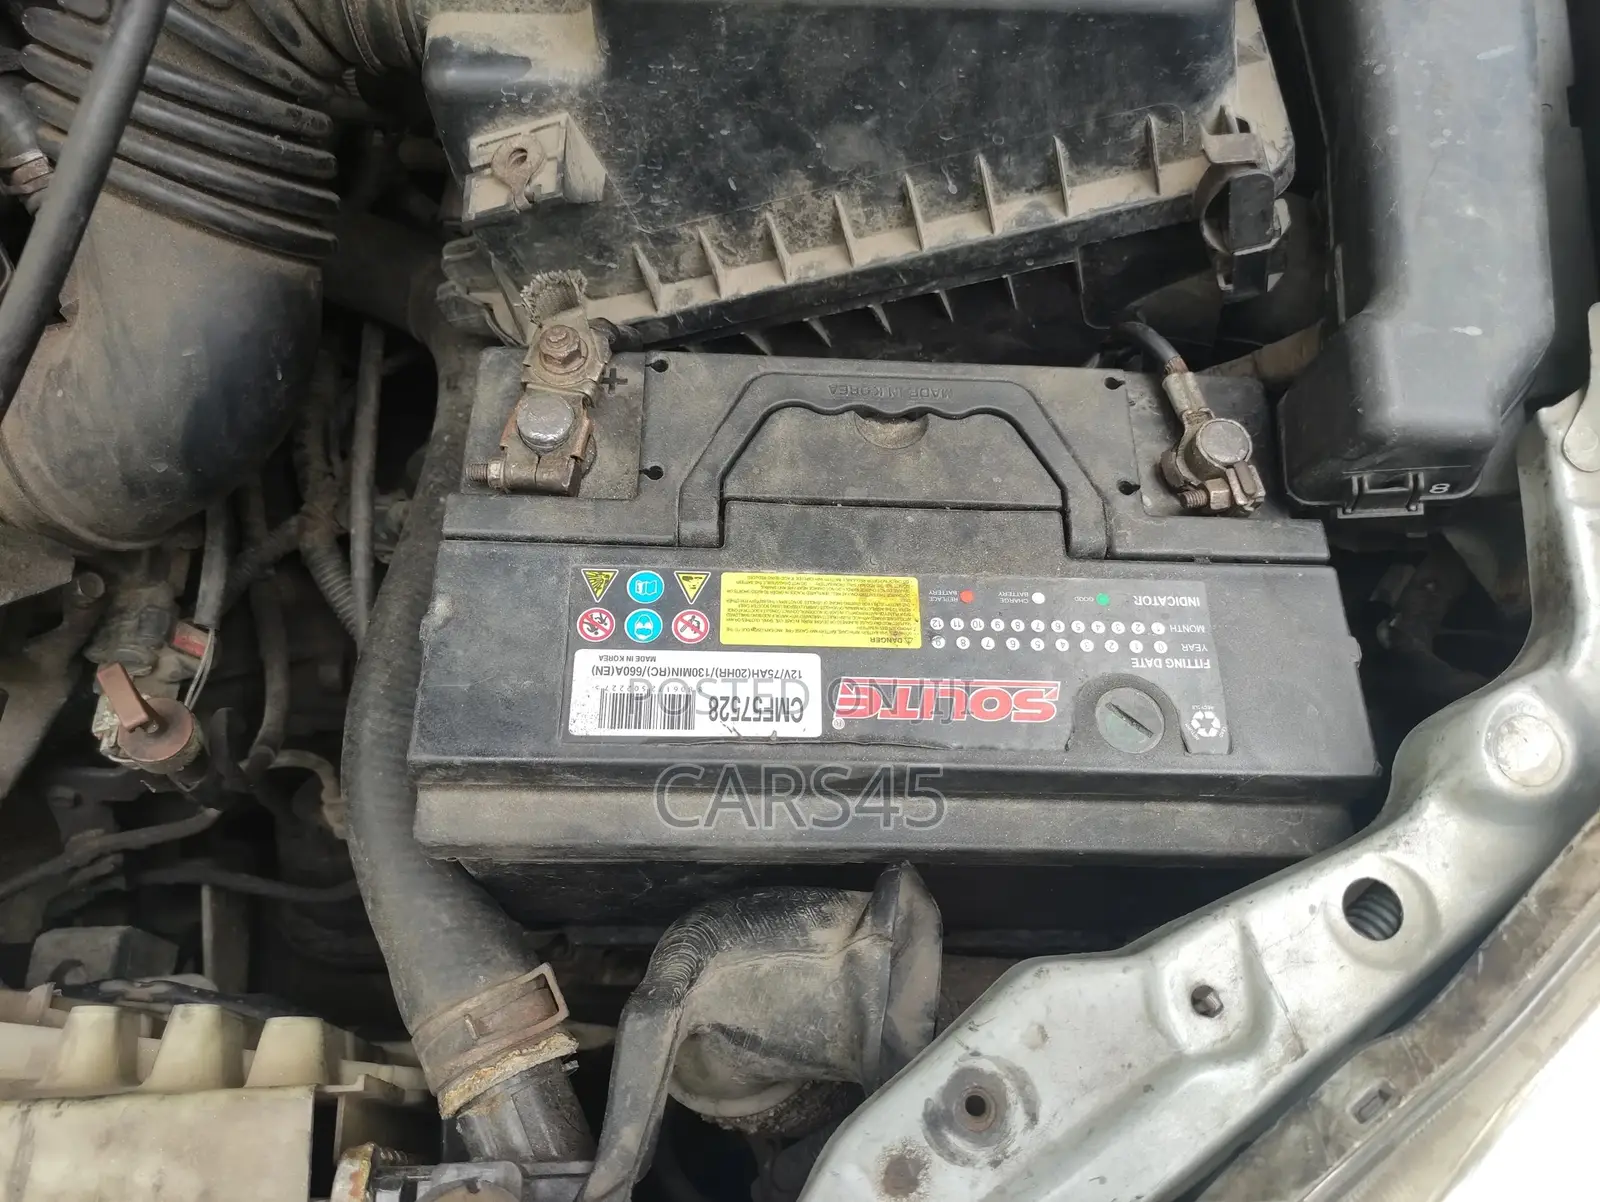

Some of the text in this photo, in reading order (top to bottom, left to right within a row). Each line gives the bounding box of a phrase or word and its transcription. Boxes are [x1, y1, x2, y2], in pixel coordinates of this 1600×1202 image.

[1132, 594, 1200, 607] INDICATOR
[1169, 624, 1205, 633] MONTH
[1180, 643, 1208, 652] YEAR
[598, 654, 657, 663] MADE IN KOREA
[1130, 658, 1211, 669] FITTING DATE
[591, 664, 803, 680] 12V/75AH(20HR)/130MIN(RC)/660A(EN)
[833, 677, 1060, 723] SOLITE
[708, 696, 804, 723] CMF57528
